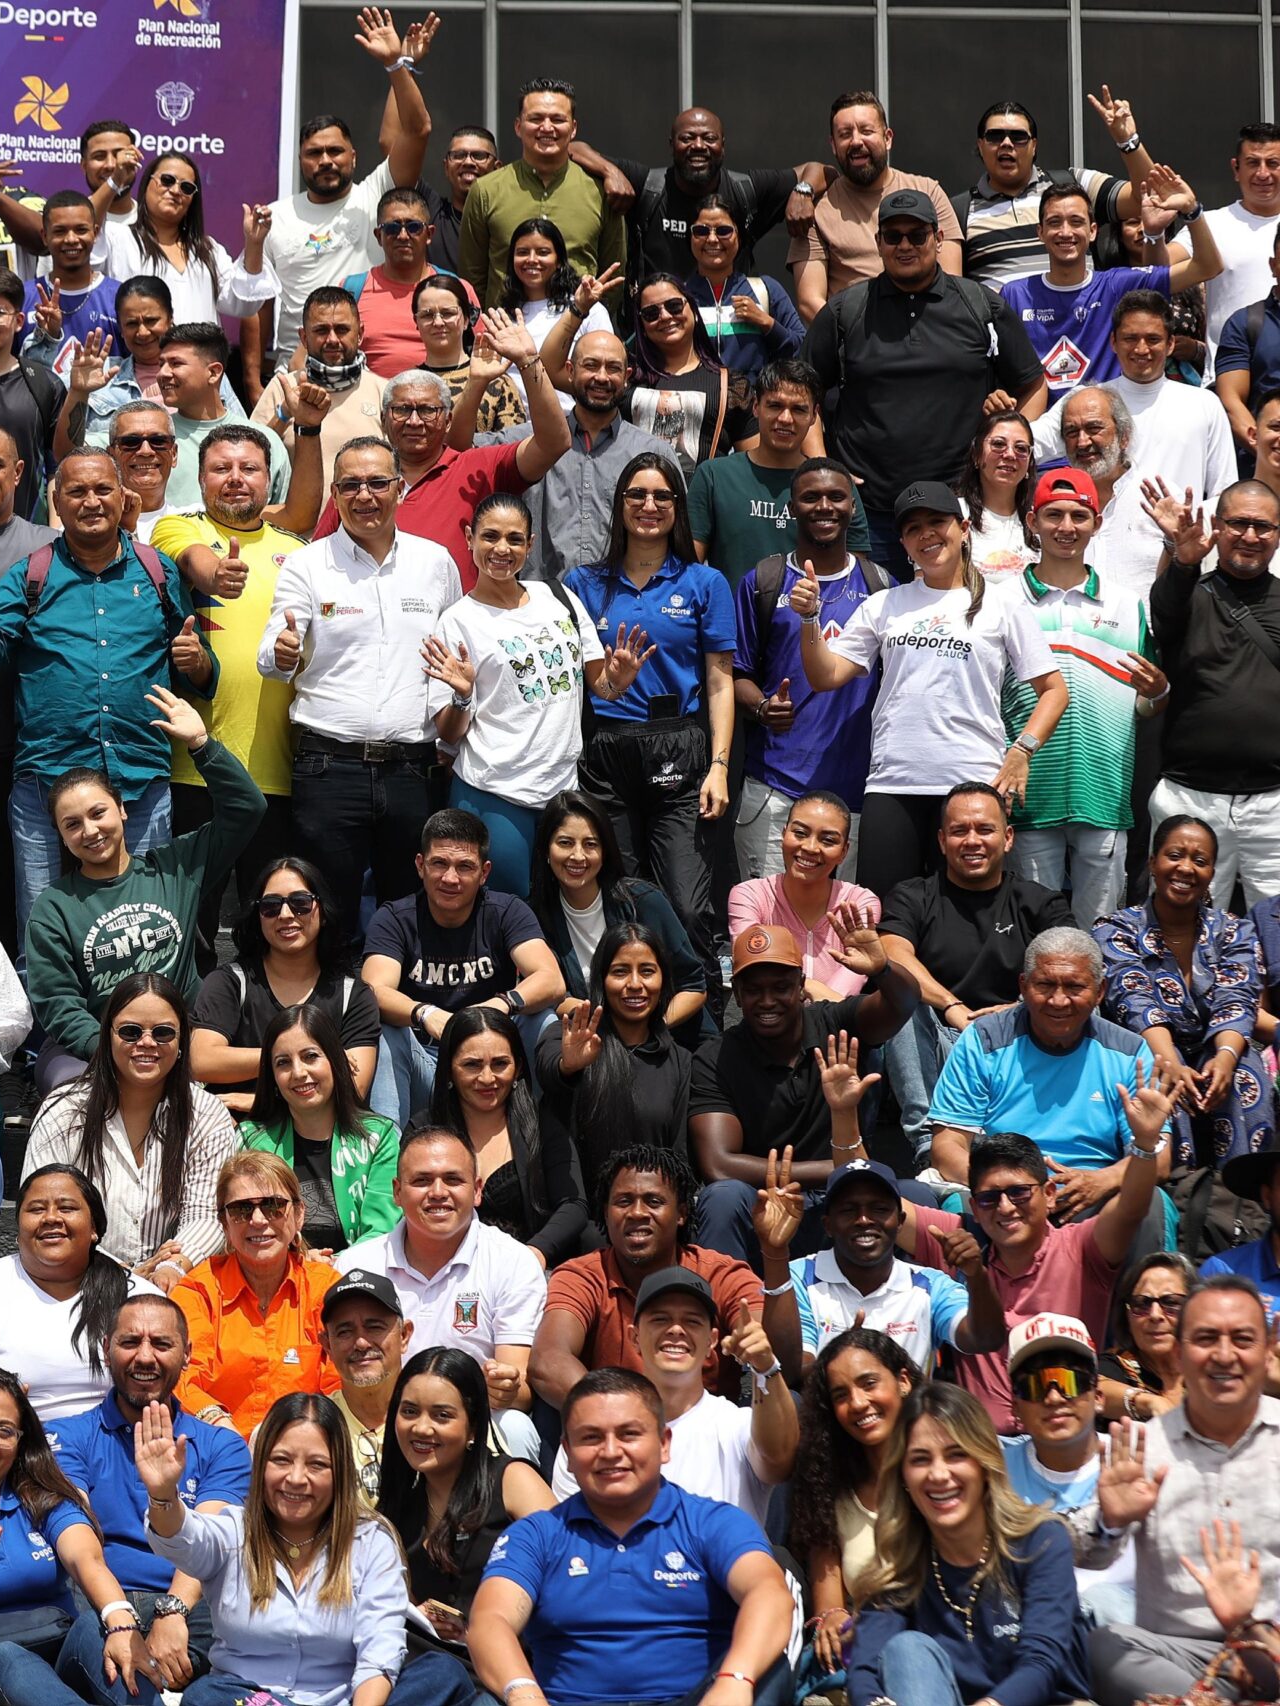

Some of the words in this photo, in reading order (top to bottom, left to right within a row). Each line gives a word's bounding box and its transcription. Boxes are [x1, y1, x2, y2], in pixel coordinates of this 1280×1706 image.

[138, 19, 164, 32] Plan
[168, 20, 220, 35] Nacional
[135, 33, 153, 46] de
[155, 34, 221, 49] Recreación
[0, 133, 25, 147] Plan
[29, 135, 81, 150] Nacional
[14, 149, 81, 164] Recreación
[1036, 314, 1054, 322] VIDA
[750, 499, 796, 520] MILA
[661, 606, 690, 616] Deporte
[936, 649, 970, 662] CAUCA
[653, 774, 683, 784] Deporte
[83, 925, 100, 972] EASTERN
[96, 903, 141, 928] ACADEMY
[112, 924, 157, 959] NYC
[92, 967, 135, 991] New
[134, 934, 178, 973] York
[409, 956, 495, 986] AMCNO
[654, 1570, 700, 1582] Deporte
